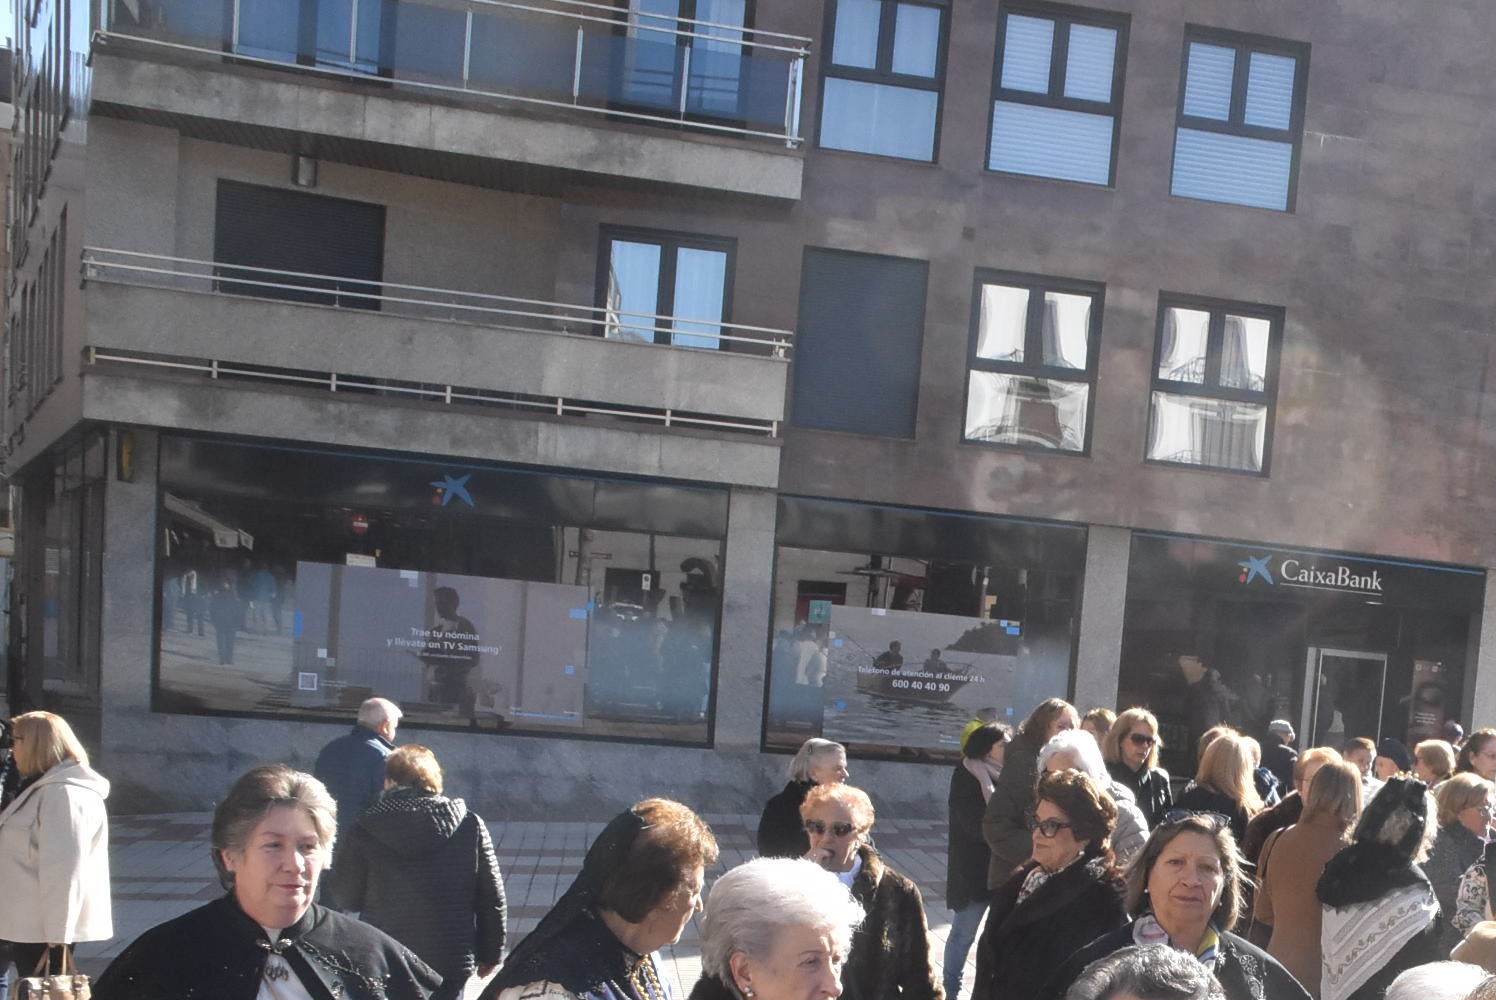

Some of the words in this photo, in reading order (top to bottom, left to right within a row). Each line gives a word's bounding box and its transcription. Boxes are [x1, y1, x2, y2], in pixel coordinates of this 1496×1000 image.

[1281, 559, 1384, 591] CaixaBank
[411, 627, 430, 637] Trae
[432, 629, 443, 638] tu
[445, 631, 480, 641] nómina
[386, 638, 393, 648] y
[428, 641, 441, 649] un
[443, 641, 456, 650] TV
[891, 668, 901, 676] de
[902, 669, 934, 679] atención
[935, 671, 943, 679] al
[944, 671, 968, 682] cliente
[892, 679, 910, 689] 600
[911, 681, 923, 690] 40
[925, 682, 937, 691] 40
[938, 683, 951, 692] 90
